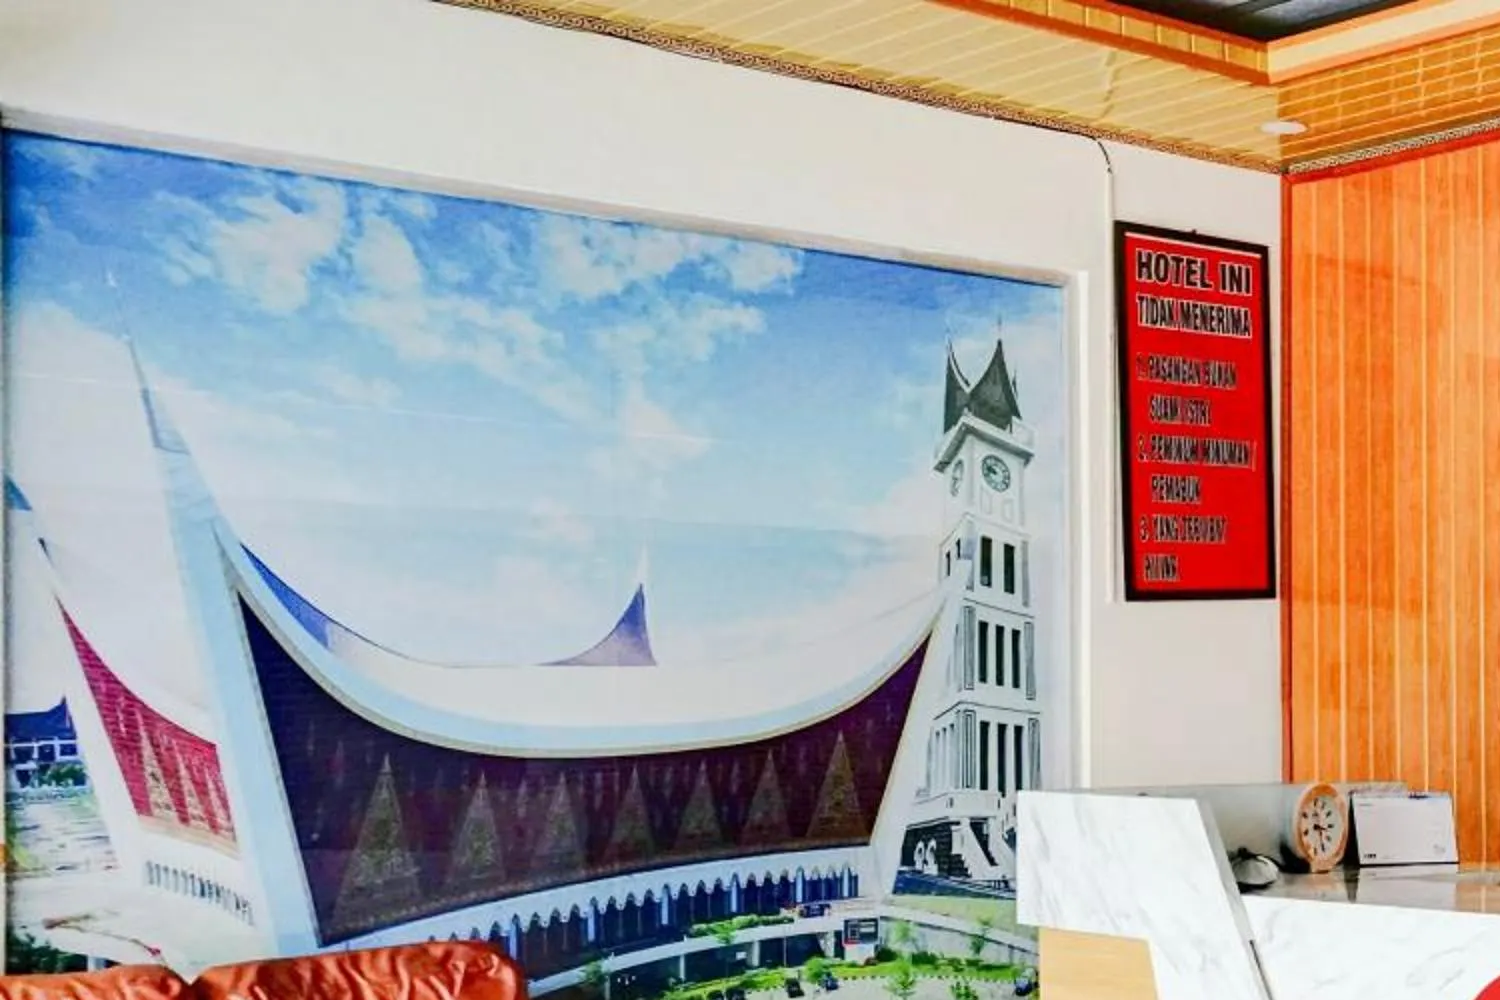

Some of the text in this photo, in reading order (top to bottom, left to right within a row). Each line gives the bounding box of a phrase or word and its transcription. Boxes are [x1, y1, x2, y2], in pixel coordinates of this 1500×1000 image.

[1136, 248, 1252, 296] HOTEL INI
[1136, 293, 1252, 339] TIDAK MENERIMA
